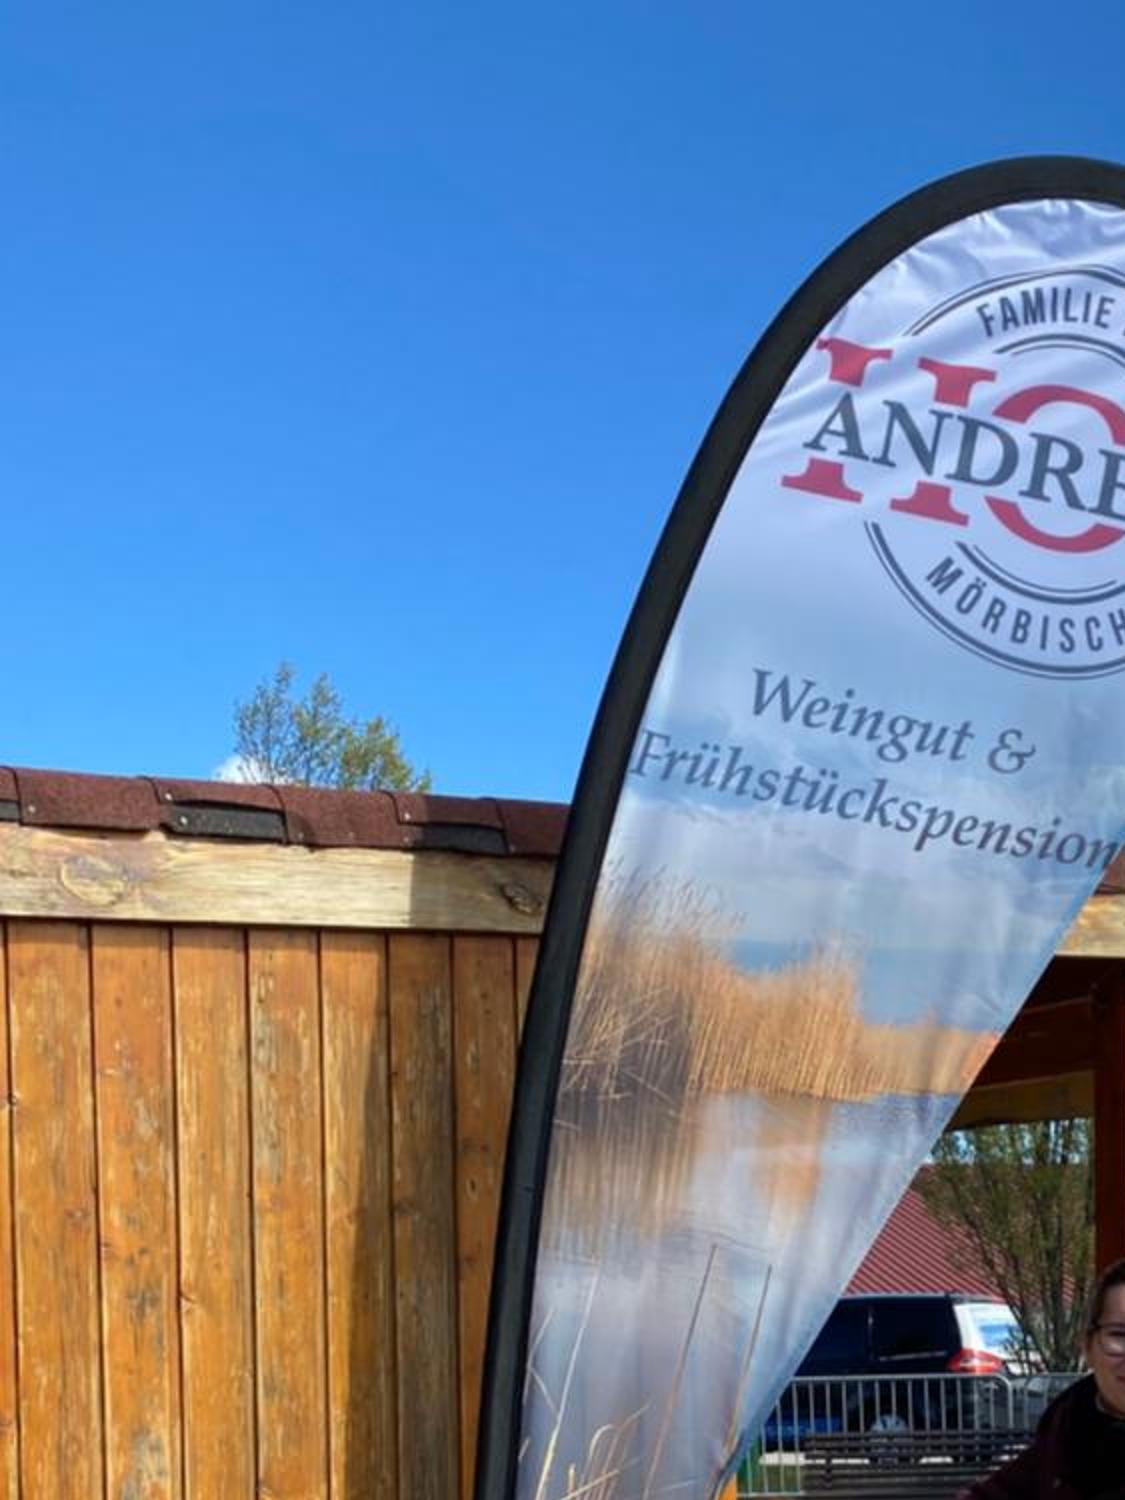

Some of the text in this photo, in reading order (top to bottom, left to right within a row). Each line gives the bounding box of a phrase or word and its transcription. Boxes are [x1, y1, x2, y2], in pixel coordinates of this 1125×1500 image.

[977, 287, 1116, 338] FAMILIE
[751, 668, 1037, 775] Weingut &
[629, 728, 1116, 870] Frühstückspension
